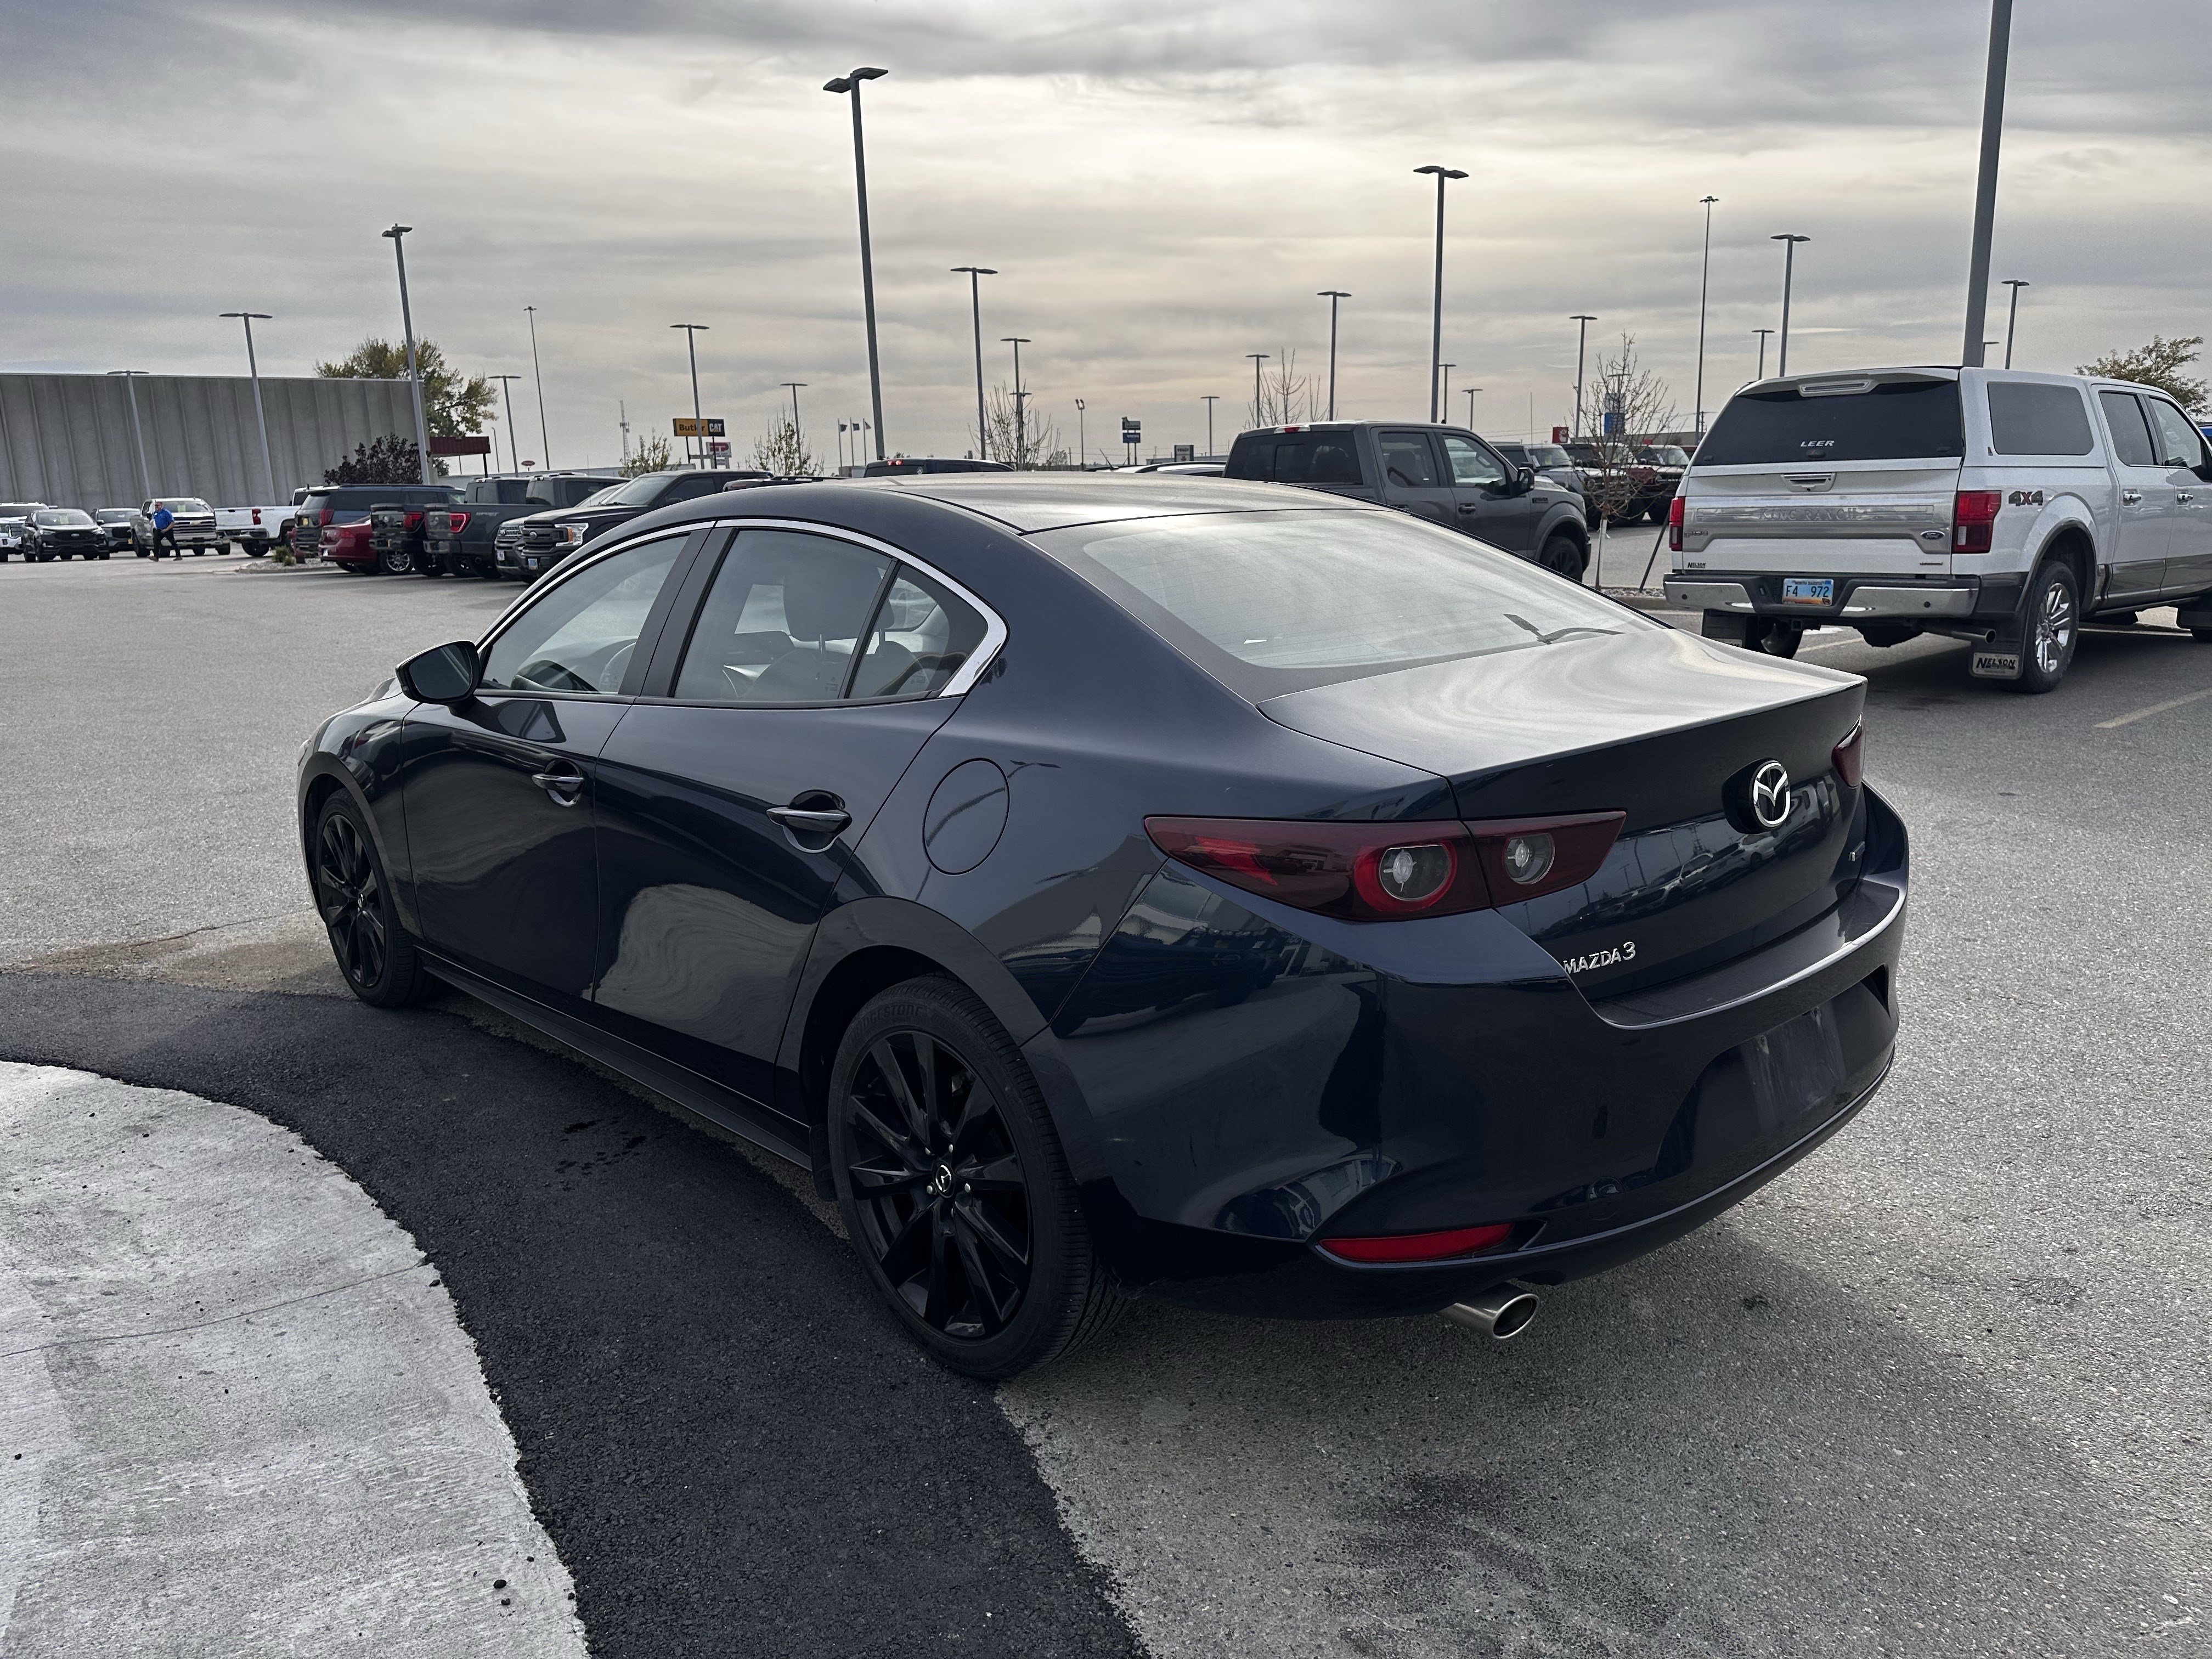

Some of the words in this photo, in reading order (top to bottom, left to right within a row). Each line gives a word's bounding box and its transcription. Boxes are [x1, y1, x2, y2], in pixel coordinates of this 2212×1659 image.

[709, 423, 722, 432] CAT
[1786, 585, 1798, 597] F4
[1811, 585, 1830, 598] 972
[1563, 941, 1636, 974] MAZDA3
[851, 1003, 924, 1042] DGESTONE
